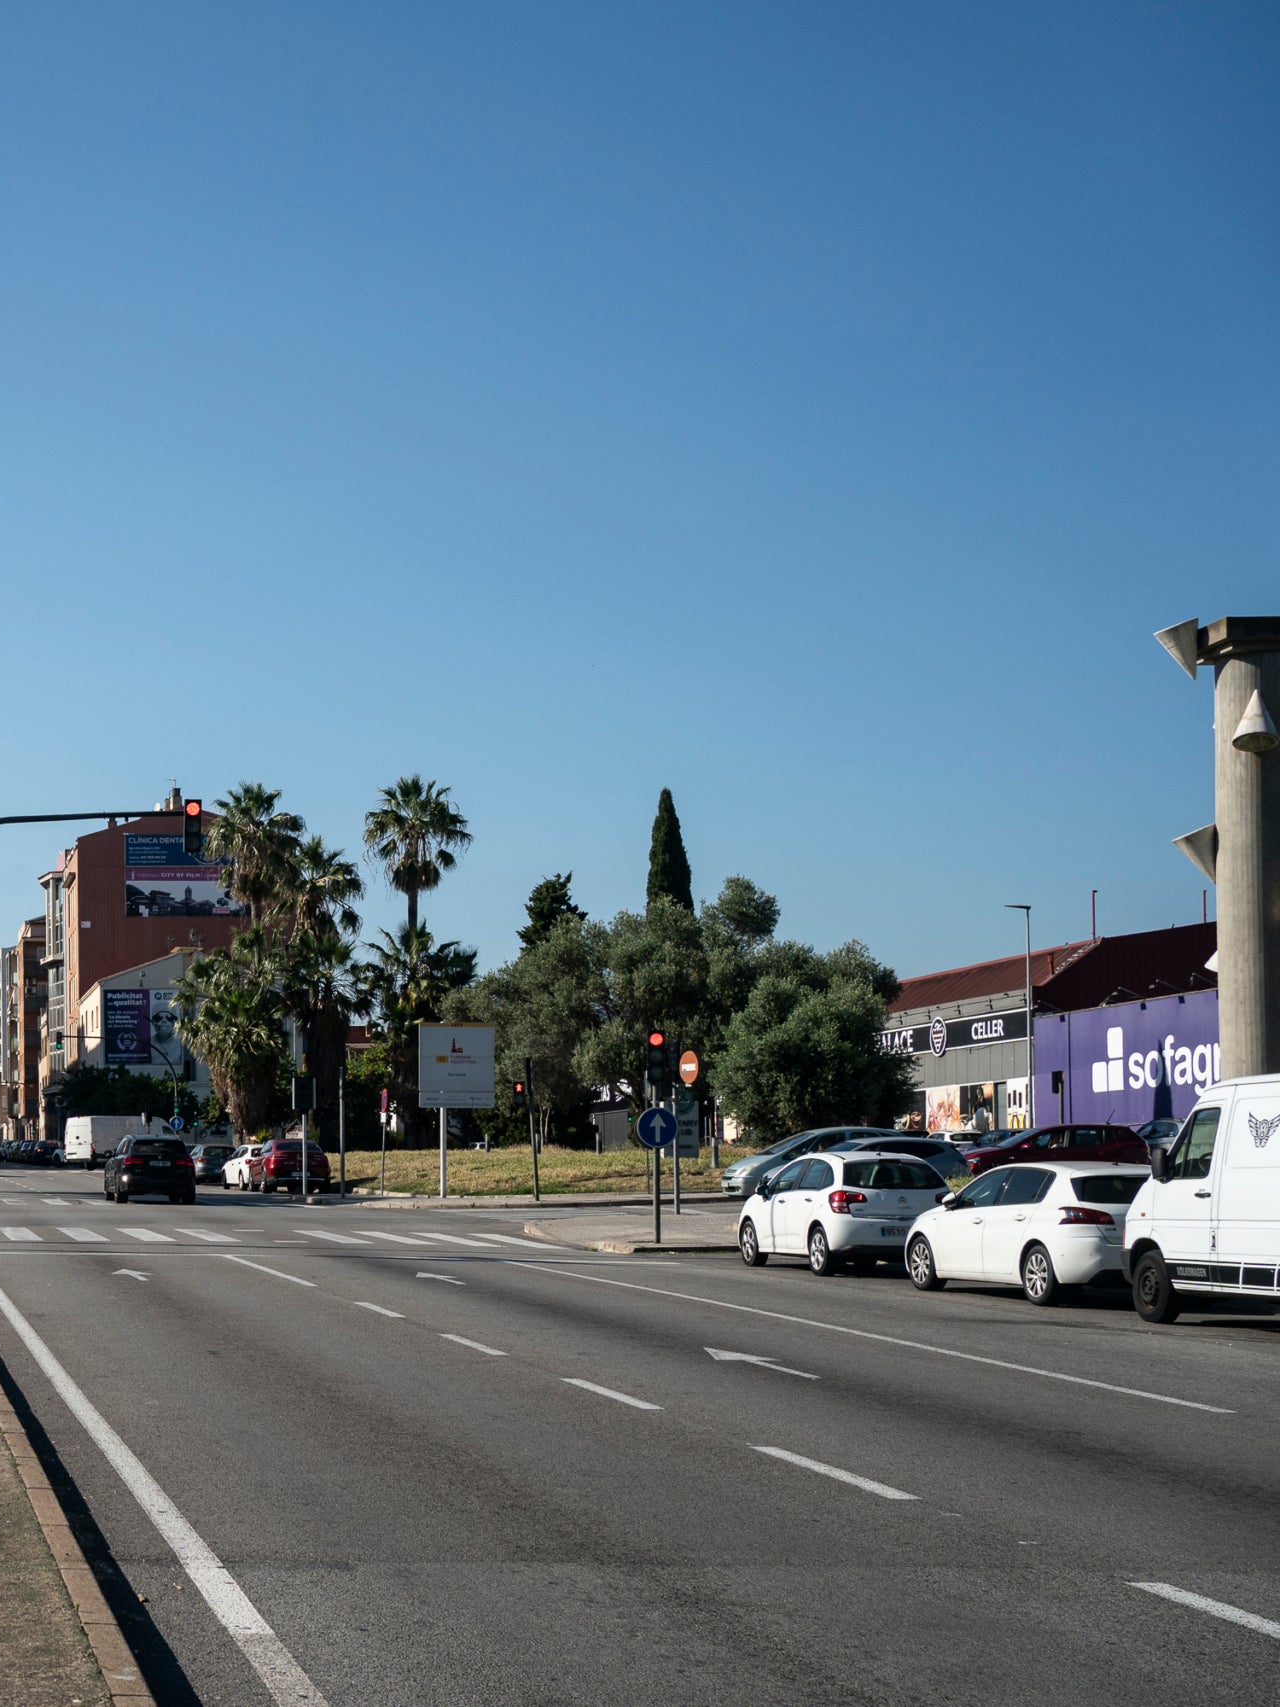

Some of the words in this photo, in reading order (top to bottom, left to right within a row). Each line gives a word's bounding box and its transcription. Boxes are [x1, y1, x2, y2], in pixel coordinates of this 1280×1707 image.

[128, 836, 158, 844] CLÍNICA
[972, 1019, 1005, 1040] CELLER
[881, 1030, 914, 1054] ALACE
[1176, 1266, 1207, 1277] VOLKSWAGEN
